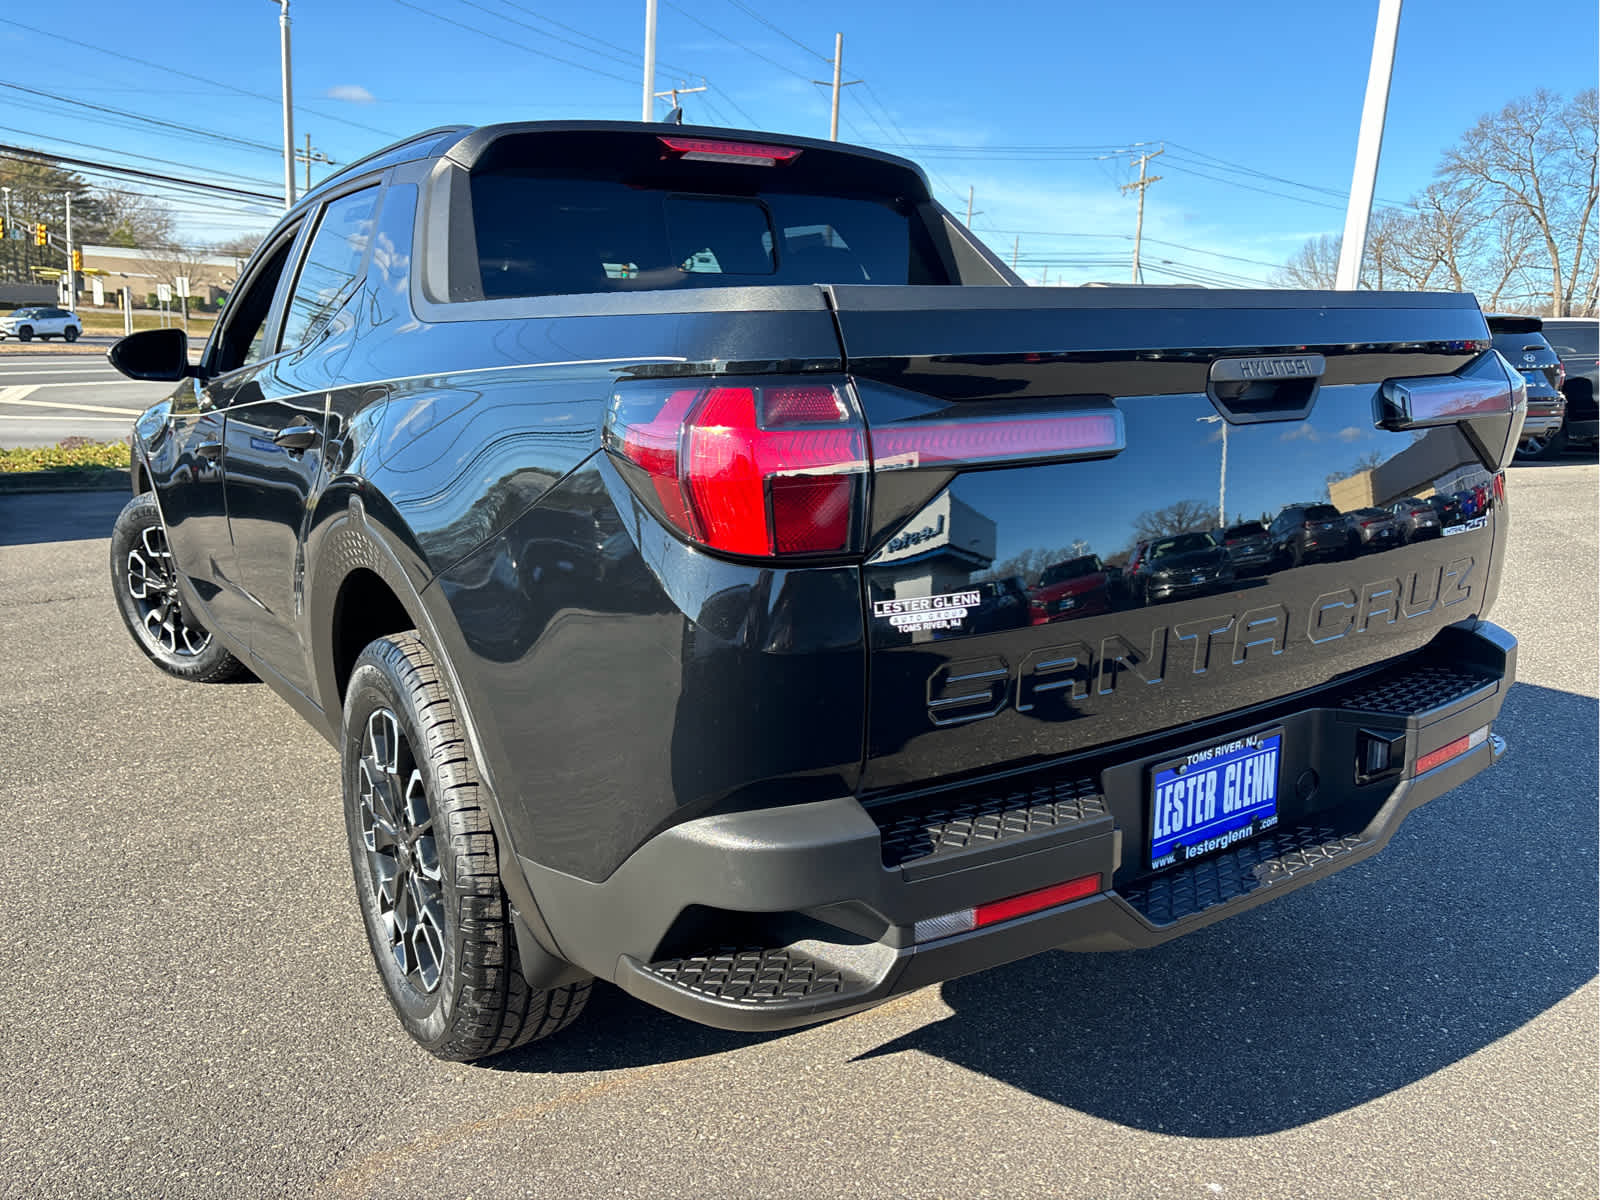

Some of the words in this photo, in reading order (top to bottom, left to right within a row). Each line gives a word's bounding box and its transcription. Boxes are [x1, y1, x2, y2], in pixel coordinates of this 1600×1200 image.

[1240, 359, 1313, 377] HYUNDAI
[874, 599, 930, 615] LESTER
[933, 593, 981, 608] GLENN
[892, 614, 923, 624] AUTO
[928, 610, 965, 620] GROUP
[896, 623, 922, 633] TOMS
[922, 619, 950, 631] RIVER,
[950, 618, 962, 628] NJ
[926, 604, 1289, 727] SANTA
[1306, 556, 1475, 645] CRUZ
[1186, 749, 1213, 766] TOMS
[1246, 735, 1258, 747] NJ
[1153, 770, 1218, 840] LESTER
[1223, 751, 1277, 814] GLENN
[1152, 854, 1177, 870] www.
[1185, 825, 1254, 860] lesterglenn
[1259, 815, 1279, 831] .com
